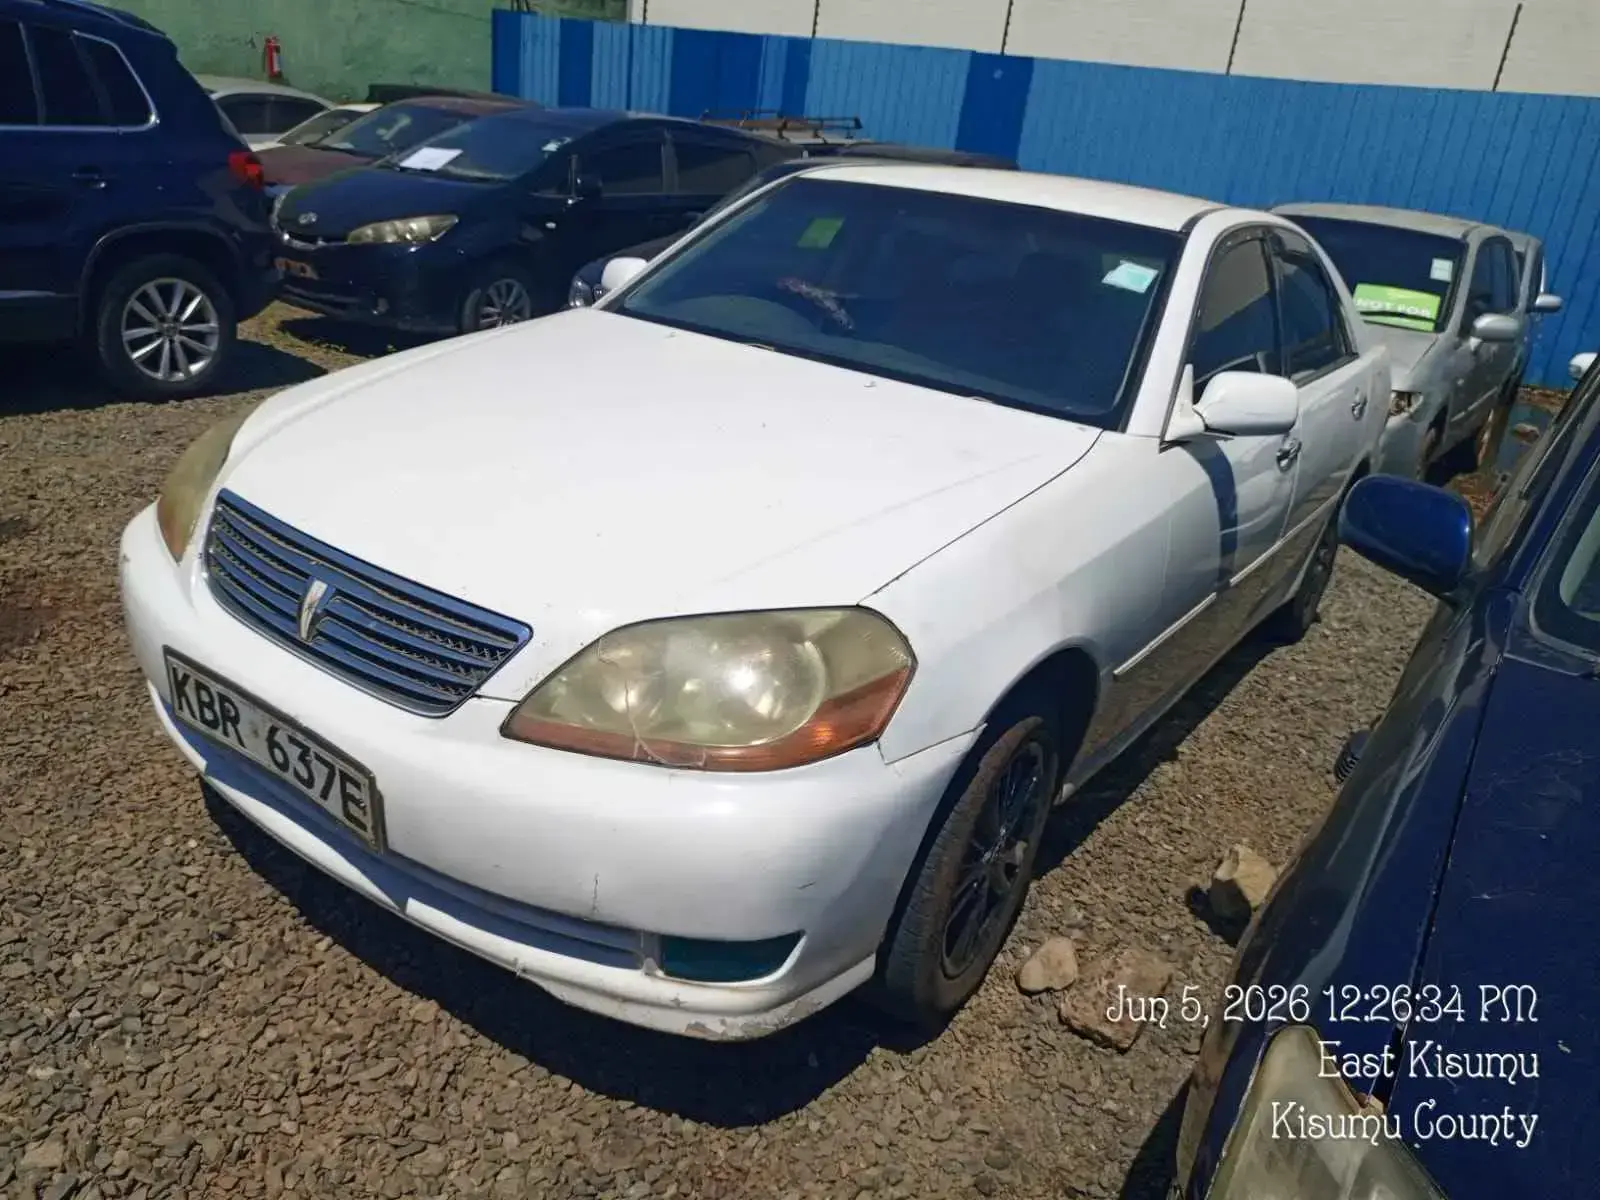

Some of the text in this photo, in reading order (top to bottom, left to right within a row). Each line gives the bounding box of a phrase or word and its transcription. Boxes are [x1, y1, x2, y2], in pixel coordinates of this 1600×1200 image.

[1356, 298, 1431, 317] NOT FOR
[172, 666, 368, 833] KBR 637E
